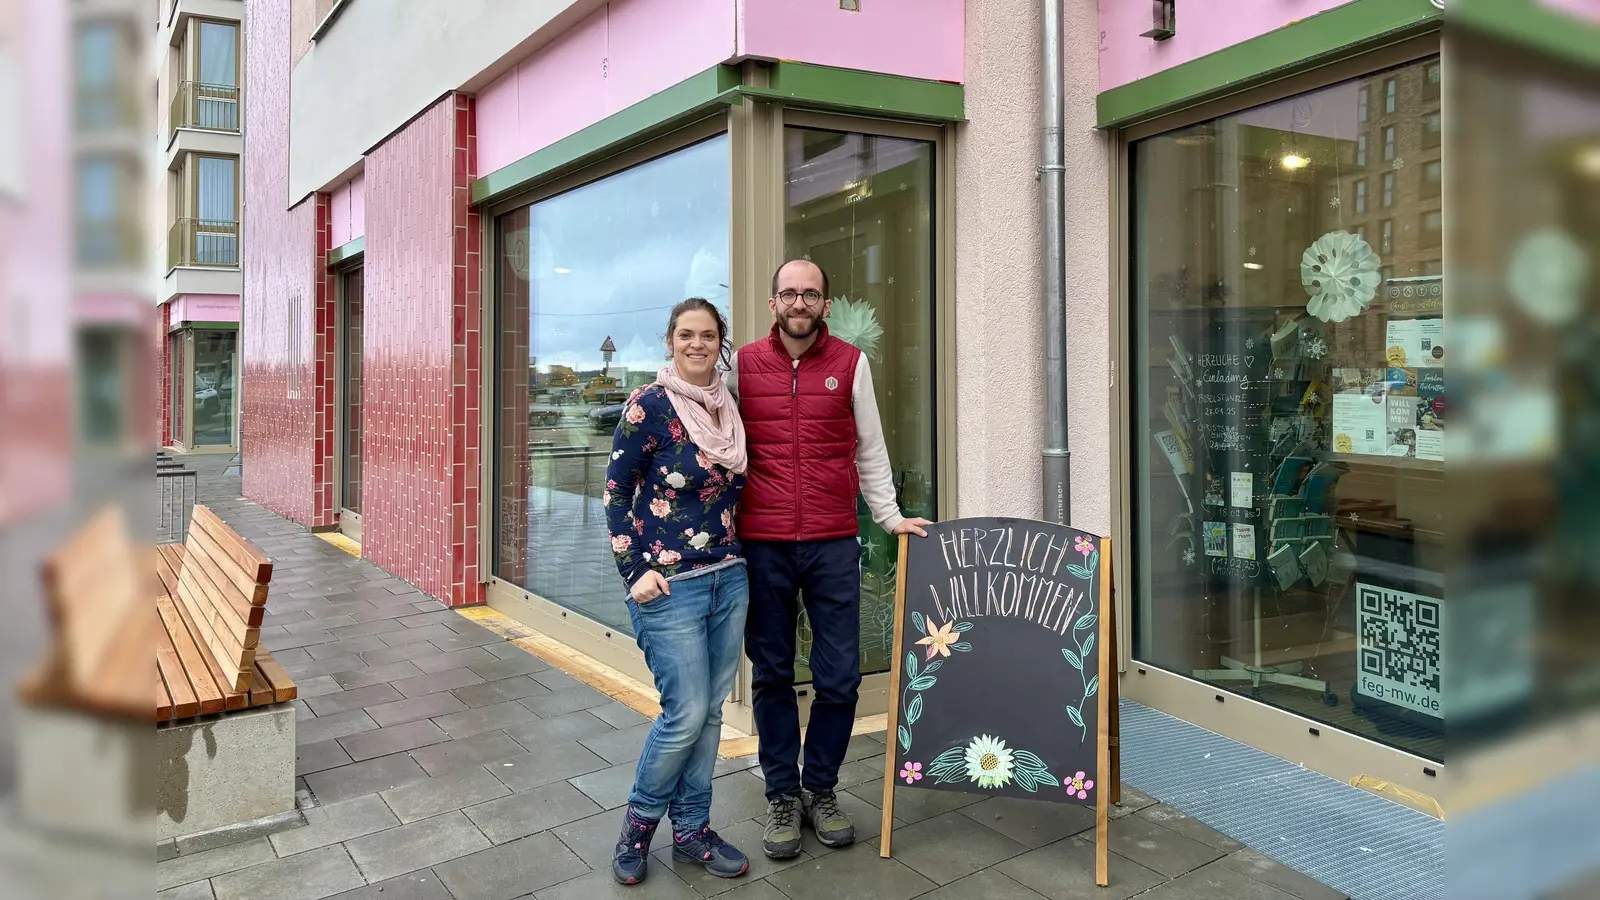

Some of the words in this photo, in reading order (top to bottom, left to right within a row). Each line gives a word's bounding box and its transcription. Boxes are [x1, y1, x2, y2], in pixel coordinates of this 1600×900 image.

[1197, 353, 1240, 368] HERZLICHE
[1202, 369, 1249, 390] Einladung
[1390, 399, 1411, 407] WILL
[1390, 407, 1410, 416] KOM
[1389, 416, 1409, 424] MEN
[939, 527, 1069, 576] HERZLICH
[929, 571, 1084, 636] WILLKOMMEN
[1361, 677, 1440, 711] feg-mw.de
